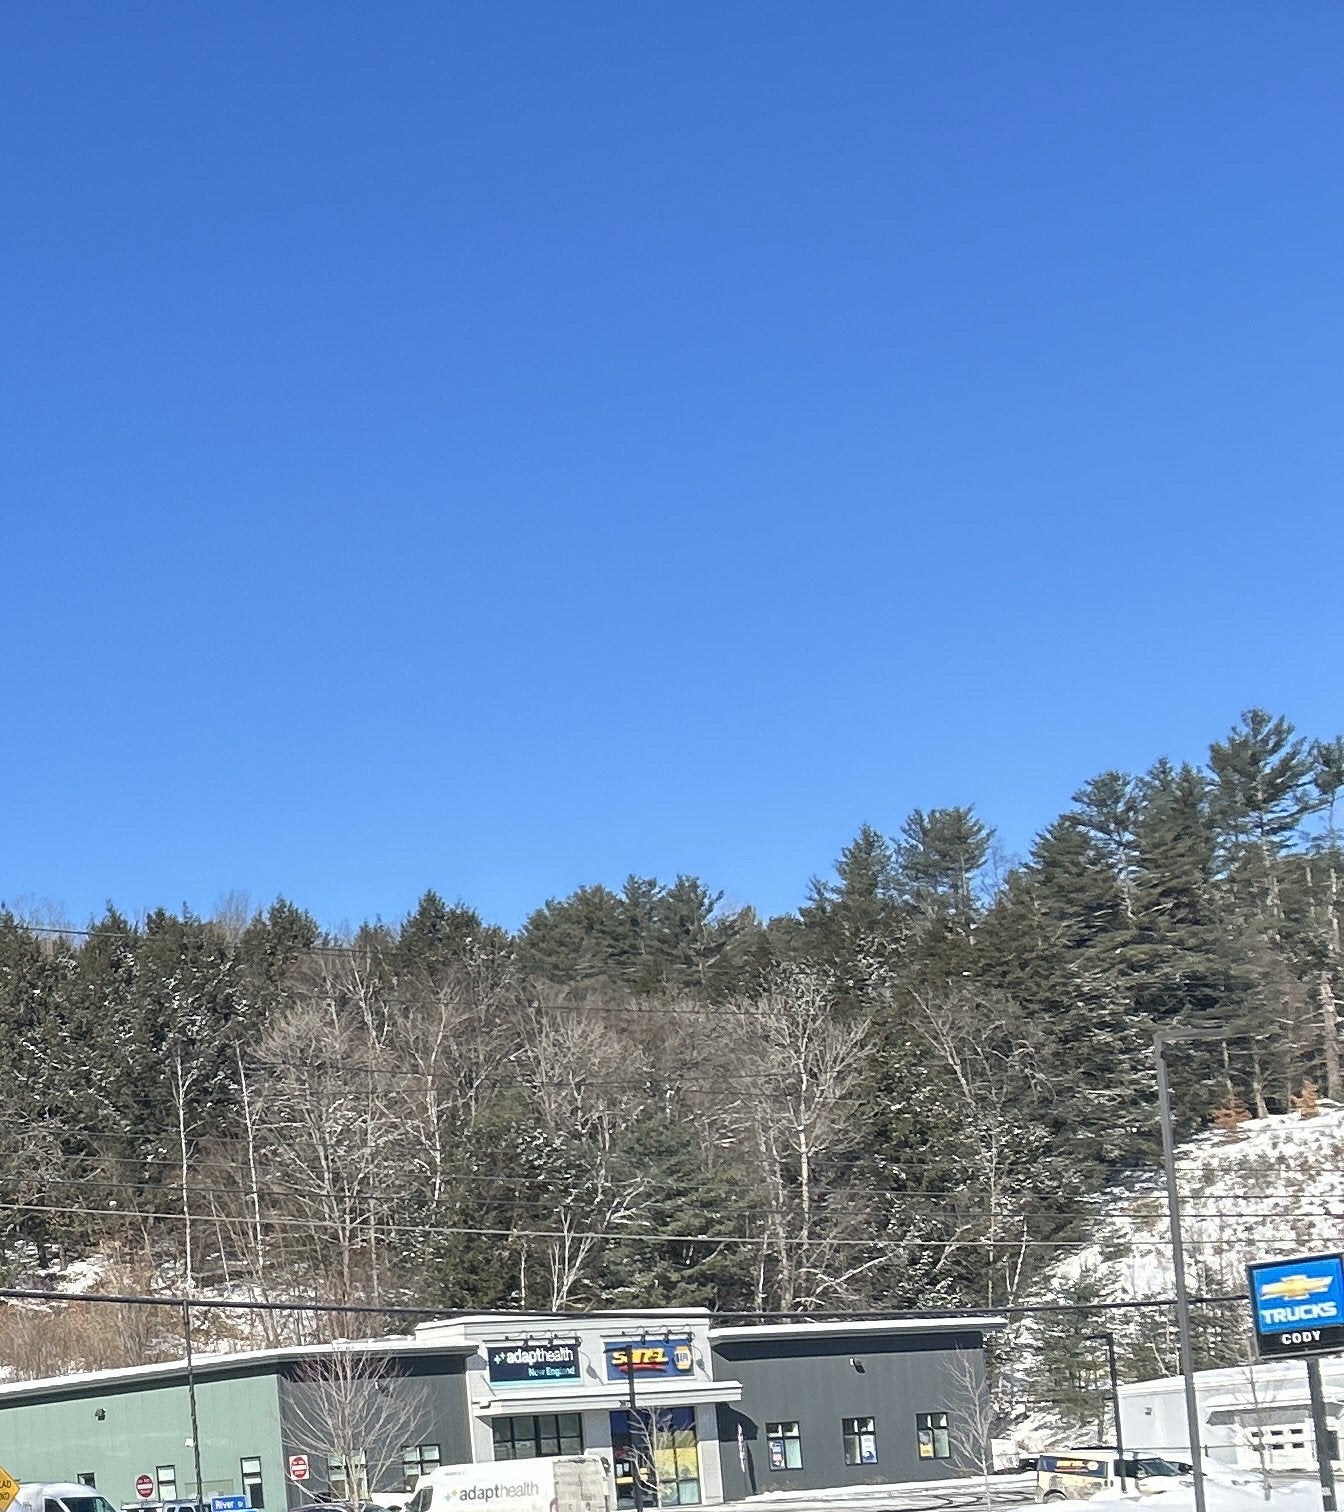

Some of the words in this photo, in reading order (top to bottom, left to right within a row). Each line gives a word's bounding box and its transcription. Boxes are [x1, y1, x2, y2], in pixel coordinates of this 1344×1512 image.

[1260, 1301, 1337, 1324] TRUCKS
[1281, 1330, 1320, 1345] CODY
[506, 1347, 574, 1366] adapthealth
[459, 1480, 539, 1503] adapthealth
